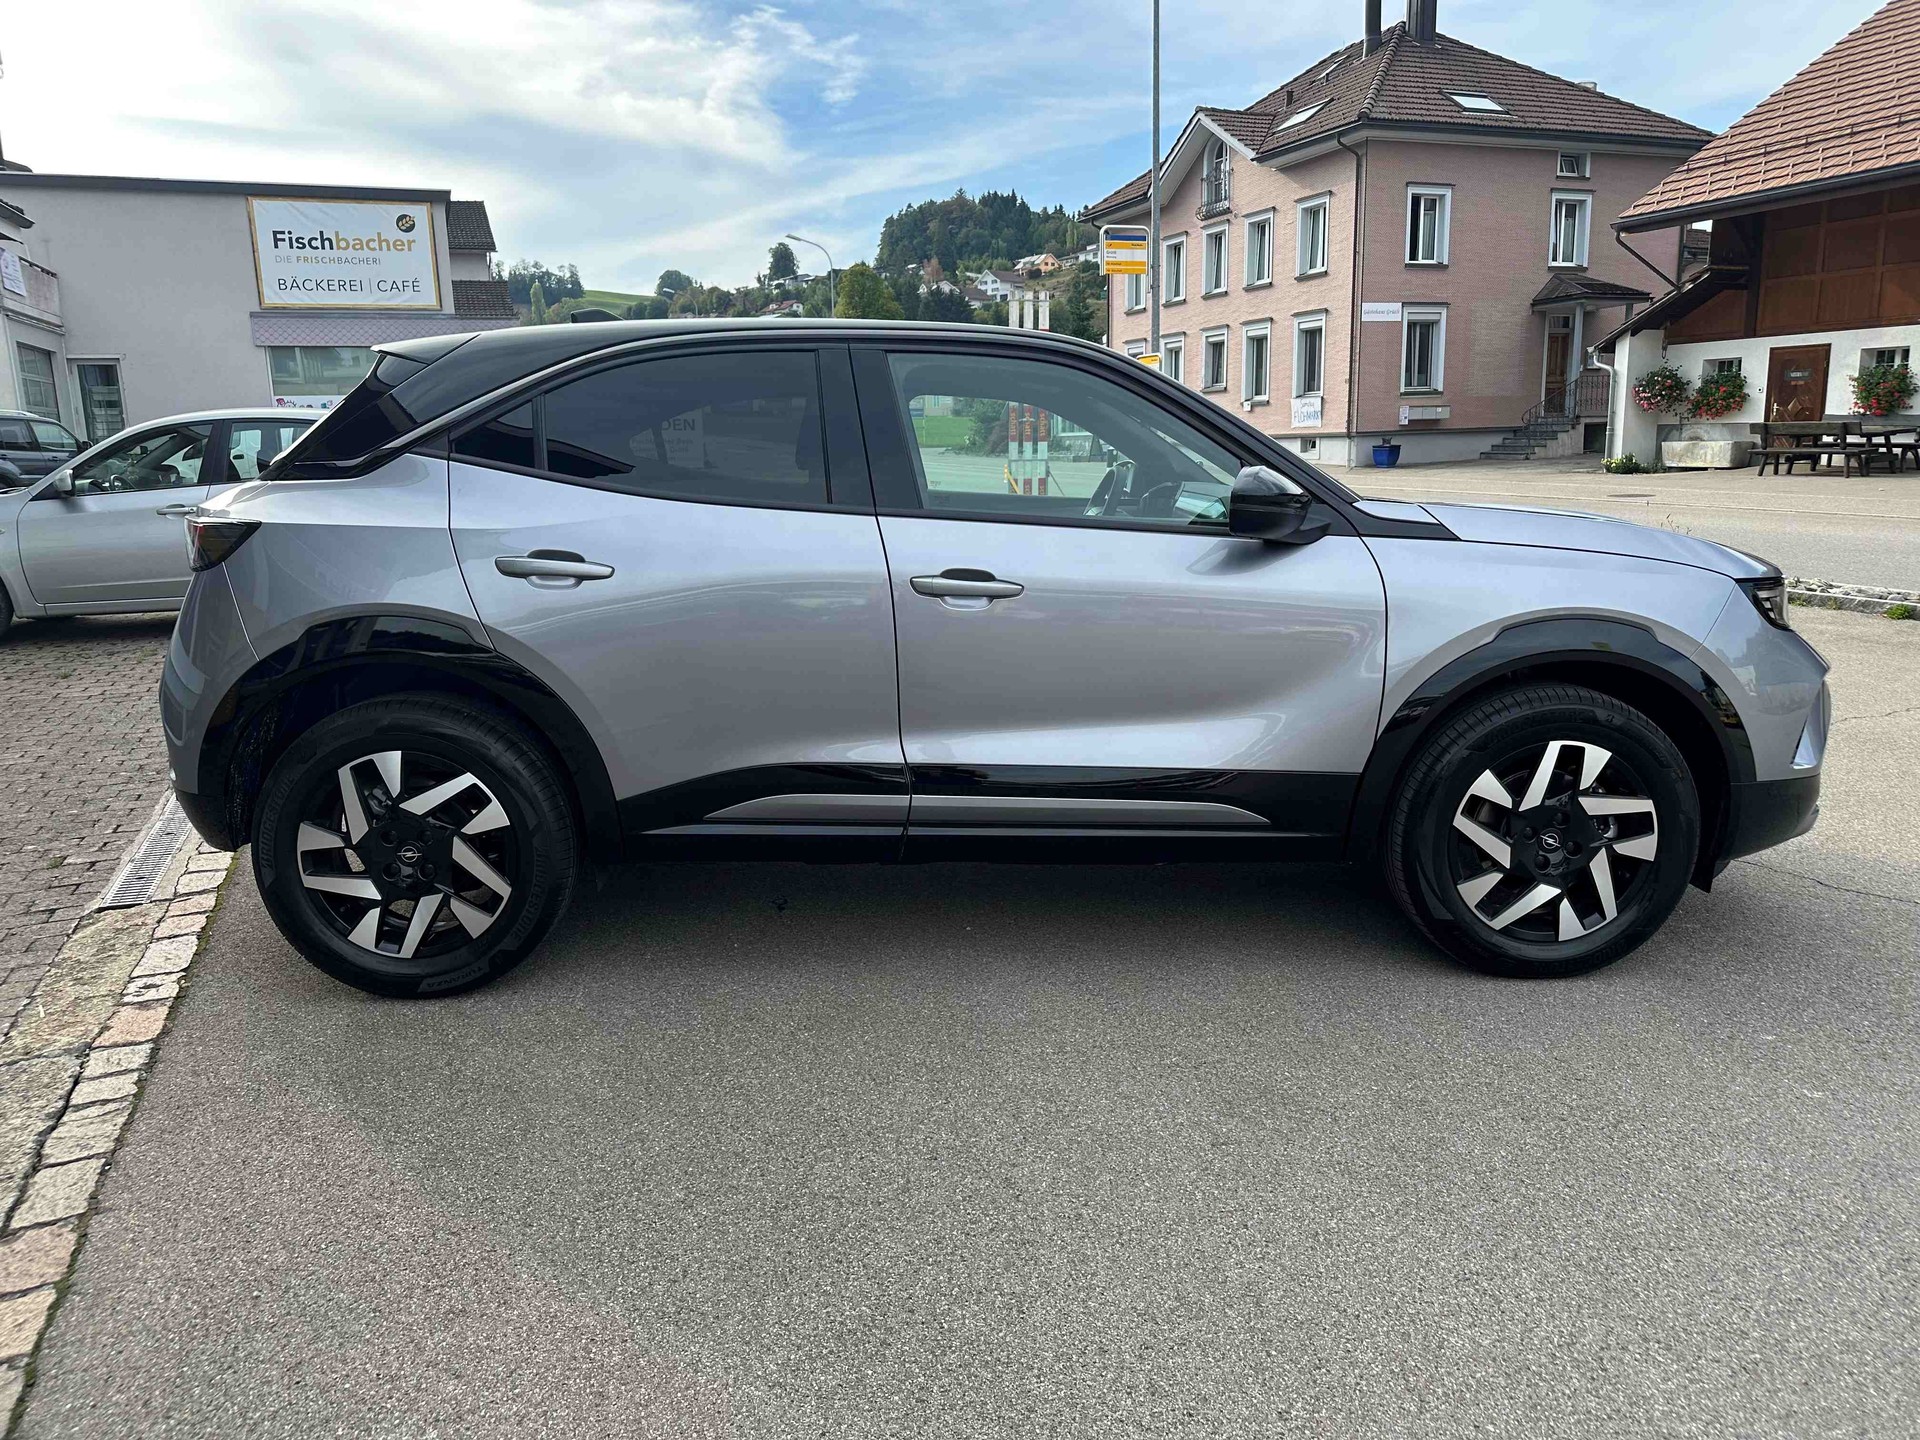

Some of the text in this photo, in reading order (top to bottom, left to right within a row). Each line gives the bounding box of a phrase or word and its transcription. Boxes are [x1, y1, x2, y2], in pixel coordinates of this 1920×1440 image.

[272, 230, 416, 252] Fischbacher
[275, 255, 292, 264] DIE
[277, 276, 421, 293] BÄCKEREI CAFÉ
